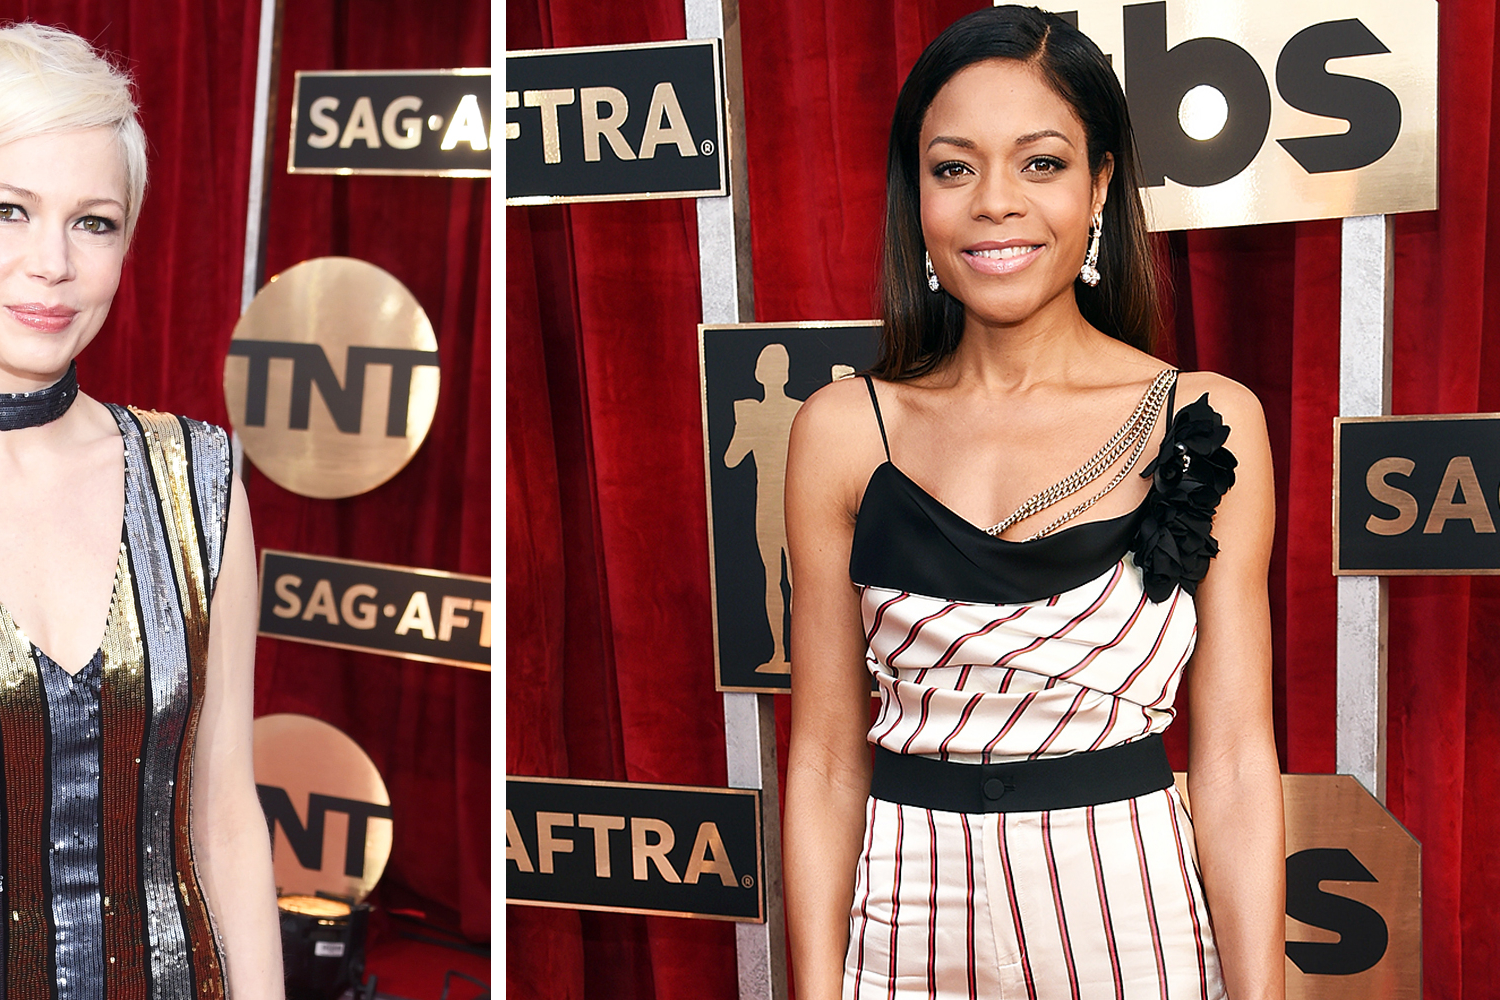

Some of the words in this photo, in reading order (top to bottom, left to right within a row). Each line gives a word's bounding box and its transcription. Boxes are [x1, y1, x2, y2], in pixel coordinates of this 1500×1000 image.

[307, 94, 491, 151] SAG·A
[1047, 0, 1402, 188] bs
[228, 339, 439, 438] TNT
[1365, 455, 1500, 536] SA
[255, 783, 393, 879] NT
